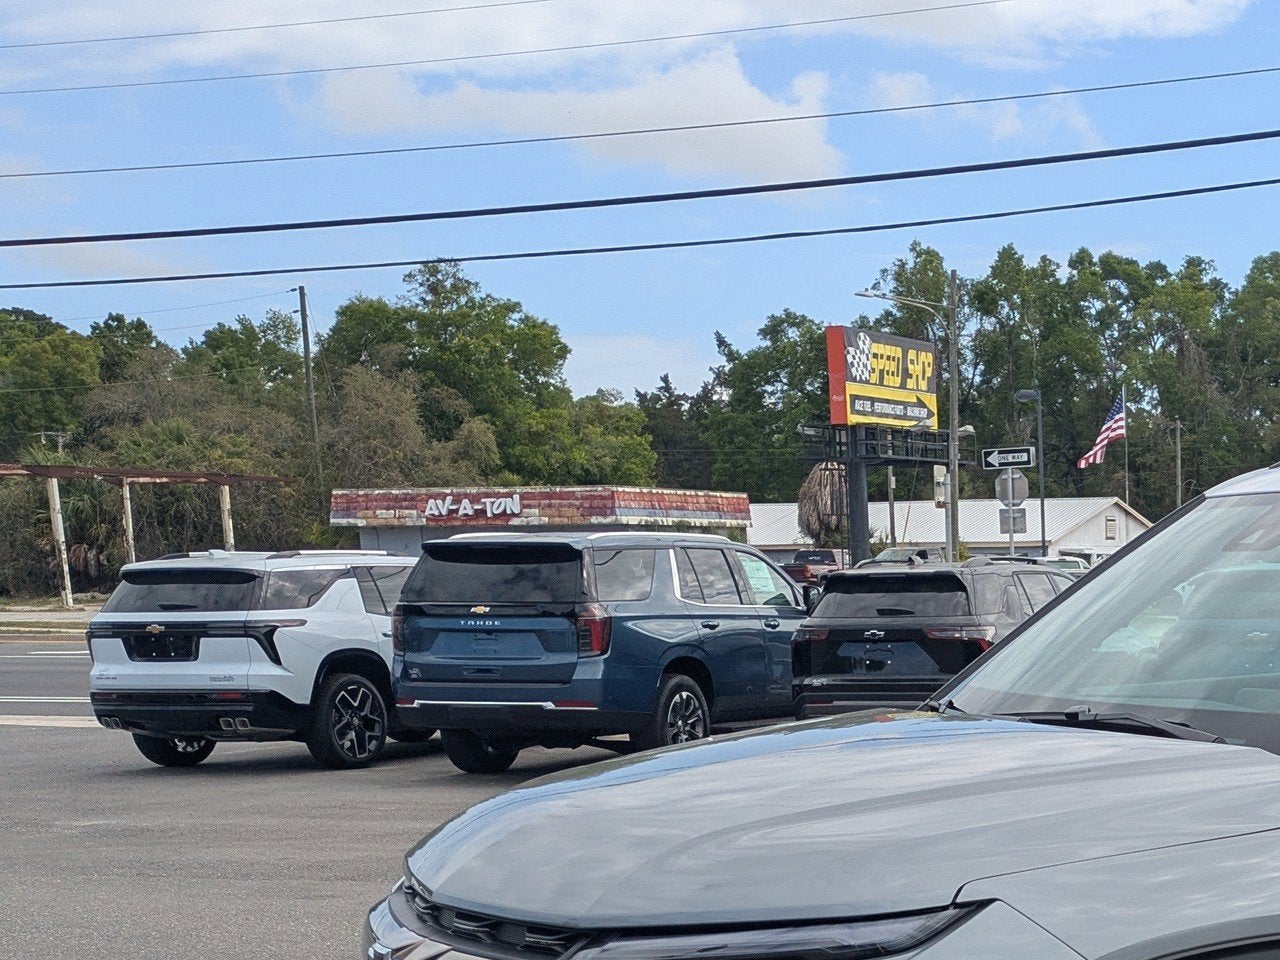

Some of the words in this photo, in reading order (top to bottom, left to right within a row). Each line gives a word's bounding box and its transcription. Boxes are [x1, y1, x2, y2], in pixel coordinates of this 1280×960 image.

[869, 342, 903, 387] SPEED
[906, 349, 933, 391] SHOP
[998, 454, 1010, 462] ONE
[1011, 453, 1024, 461] WAY
[424, 493, 521, 518] AV-A-TON
